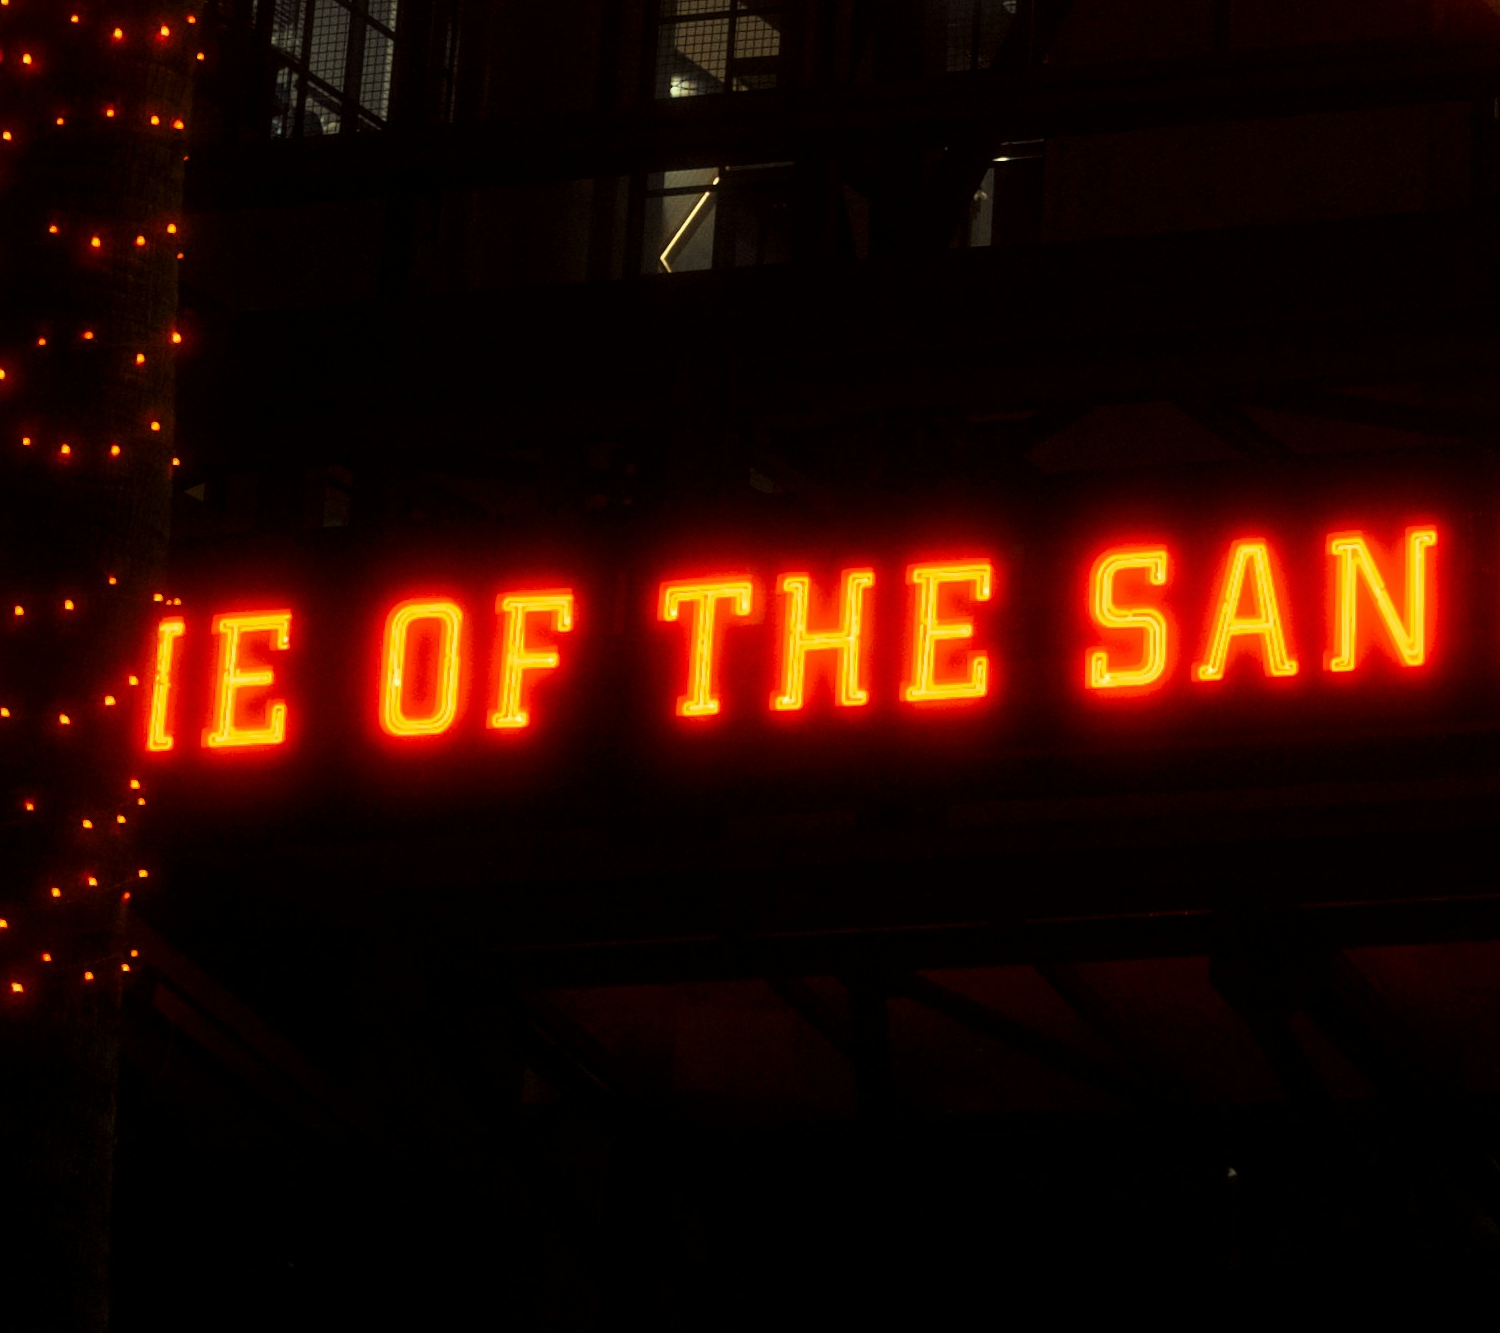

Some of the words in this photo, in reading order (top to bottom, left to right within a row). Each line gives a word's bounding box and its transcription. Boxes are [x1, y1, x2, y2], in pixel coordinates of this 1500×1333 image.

[377, 587, 576, 738] OF
[657, 558, 994, 718] THE
[1083, 525, 1439, 692] SAN
